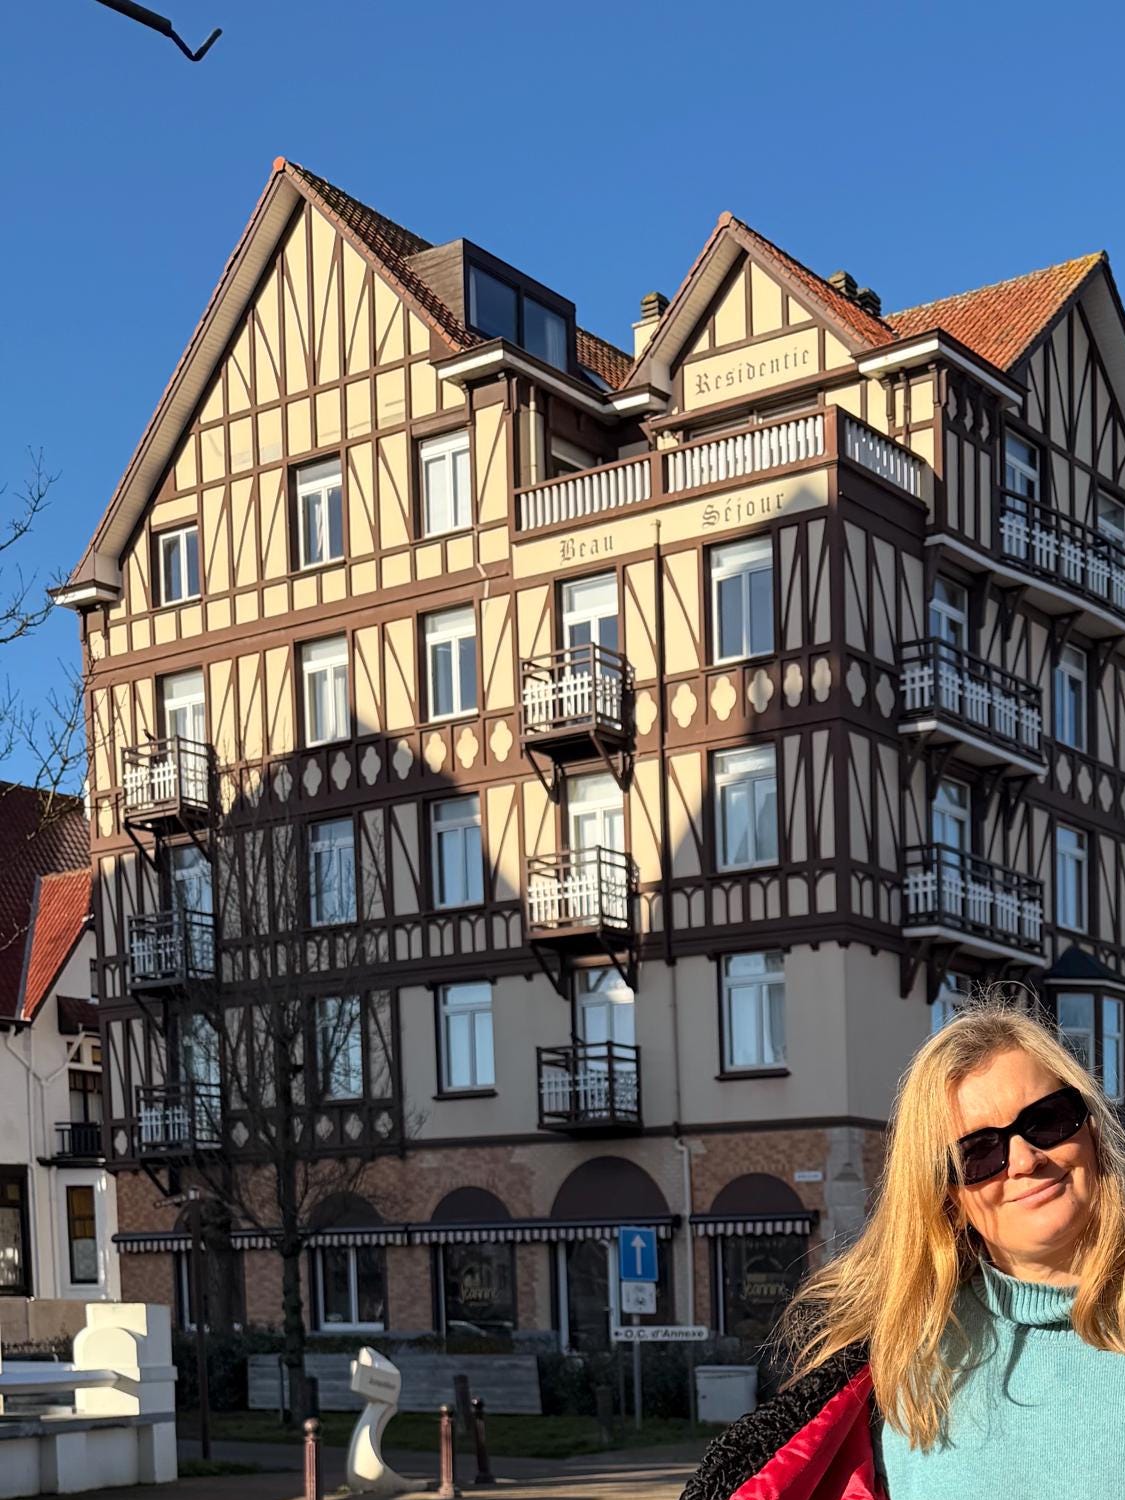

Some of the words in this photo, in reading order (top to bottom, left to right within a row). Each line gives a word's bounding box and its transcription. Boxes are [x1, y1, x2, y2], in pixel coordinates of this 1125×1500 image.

[695, 346, 809, 395] Residentie
[560, 535, 613, 565] Beau
[702, 492, 784, 527] Séjour
